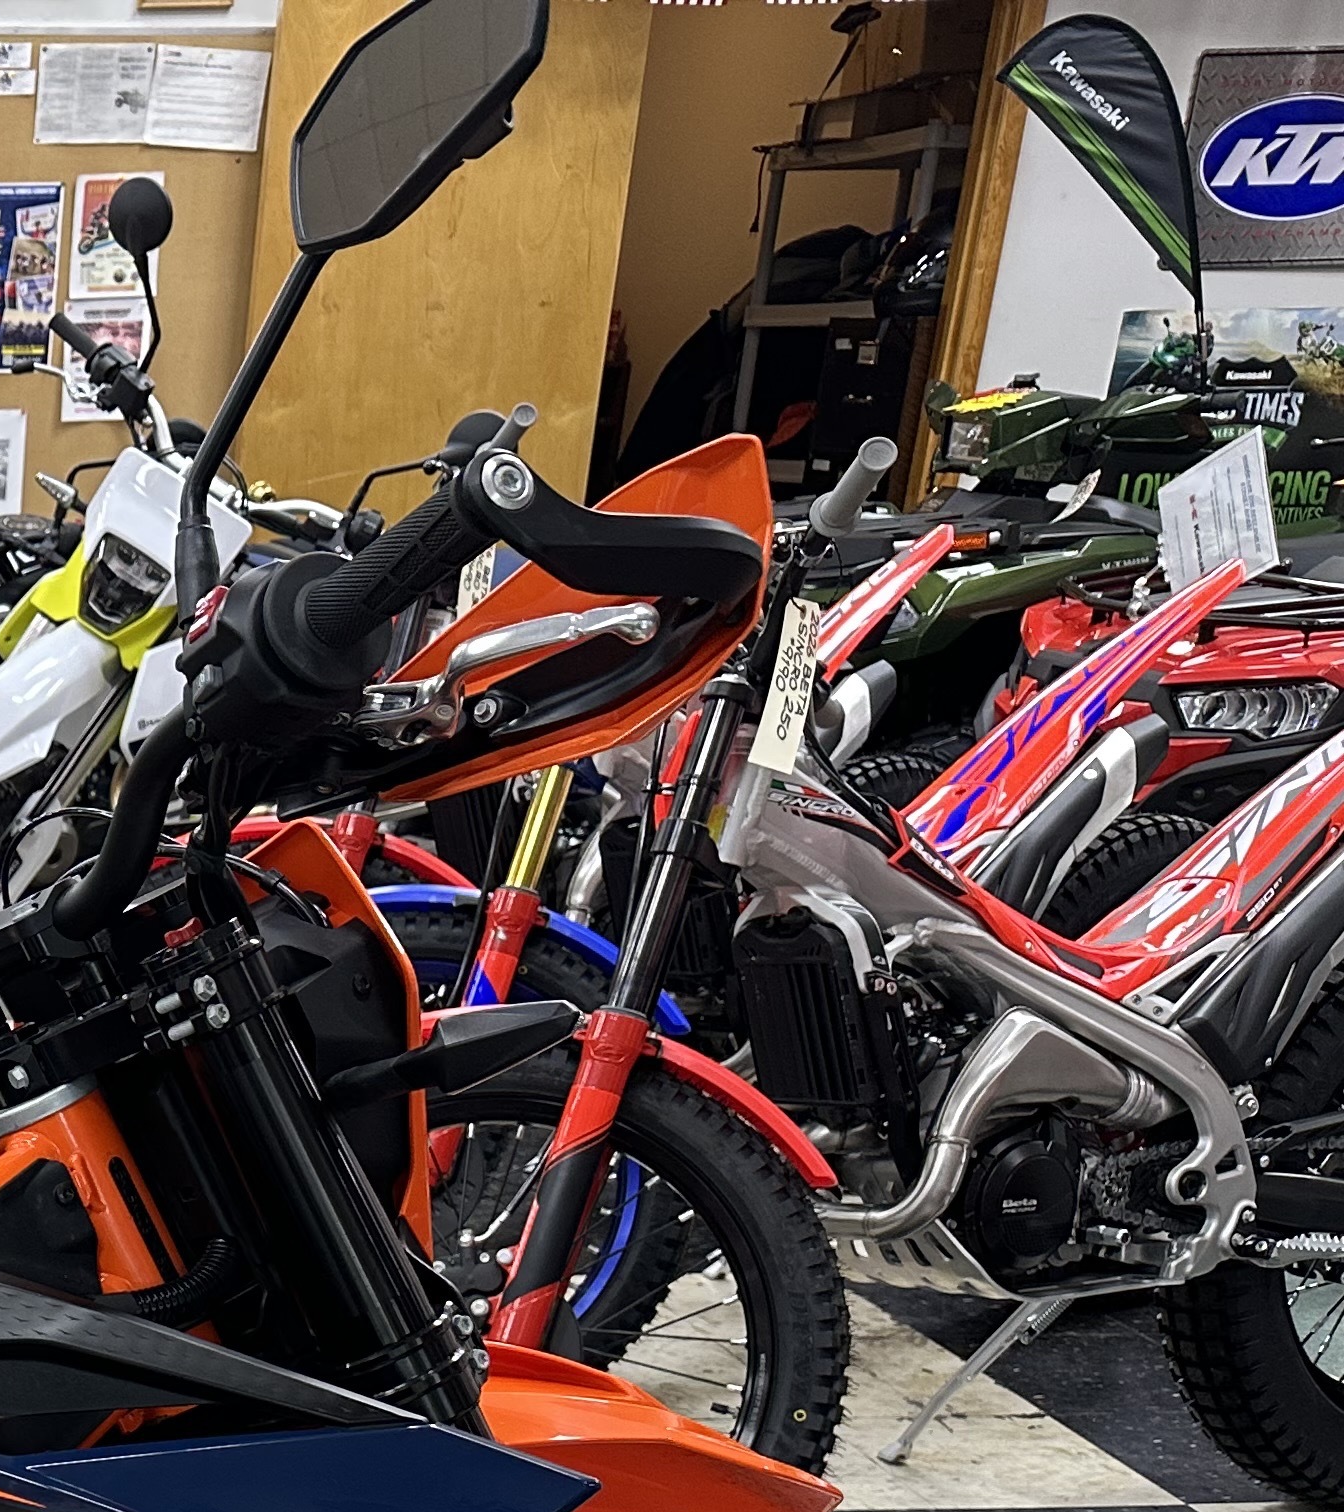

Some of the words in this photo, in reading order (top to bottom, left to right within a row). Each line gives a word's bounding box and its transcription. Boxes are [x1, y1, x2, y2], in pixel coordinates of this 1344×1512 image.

[1048, 50, 1131, 133] Kawasaki
[1225, 370, 1272, 381] Kawasaki
[1243, 391, 1305, 428] TIMES
[1211, 427, 1235, 439] ALES
[1269, 470, 1332, 506] CING
[1273, 506, 1325, 525] ENTIVES
[806, 610, 820, 659] 2026
[788, 622, 808, 691] SINCRO
[795, 663, 813, 717] BETA
[776, 695, 794, 741] 250
[768, 791, 855, 818] SINCRO
[909, 837, 954, 880] Beta
[1245, 890, 1275, 922] 250
